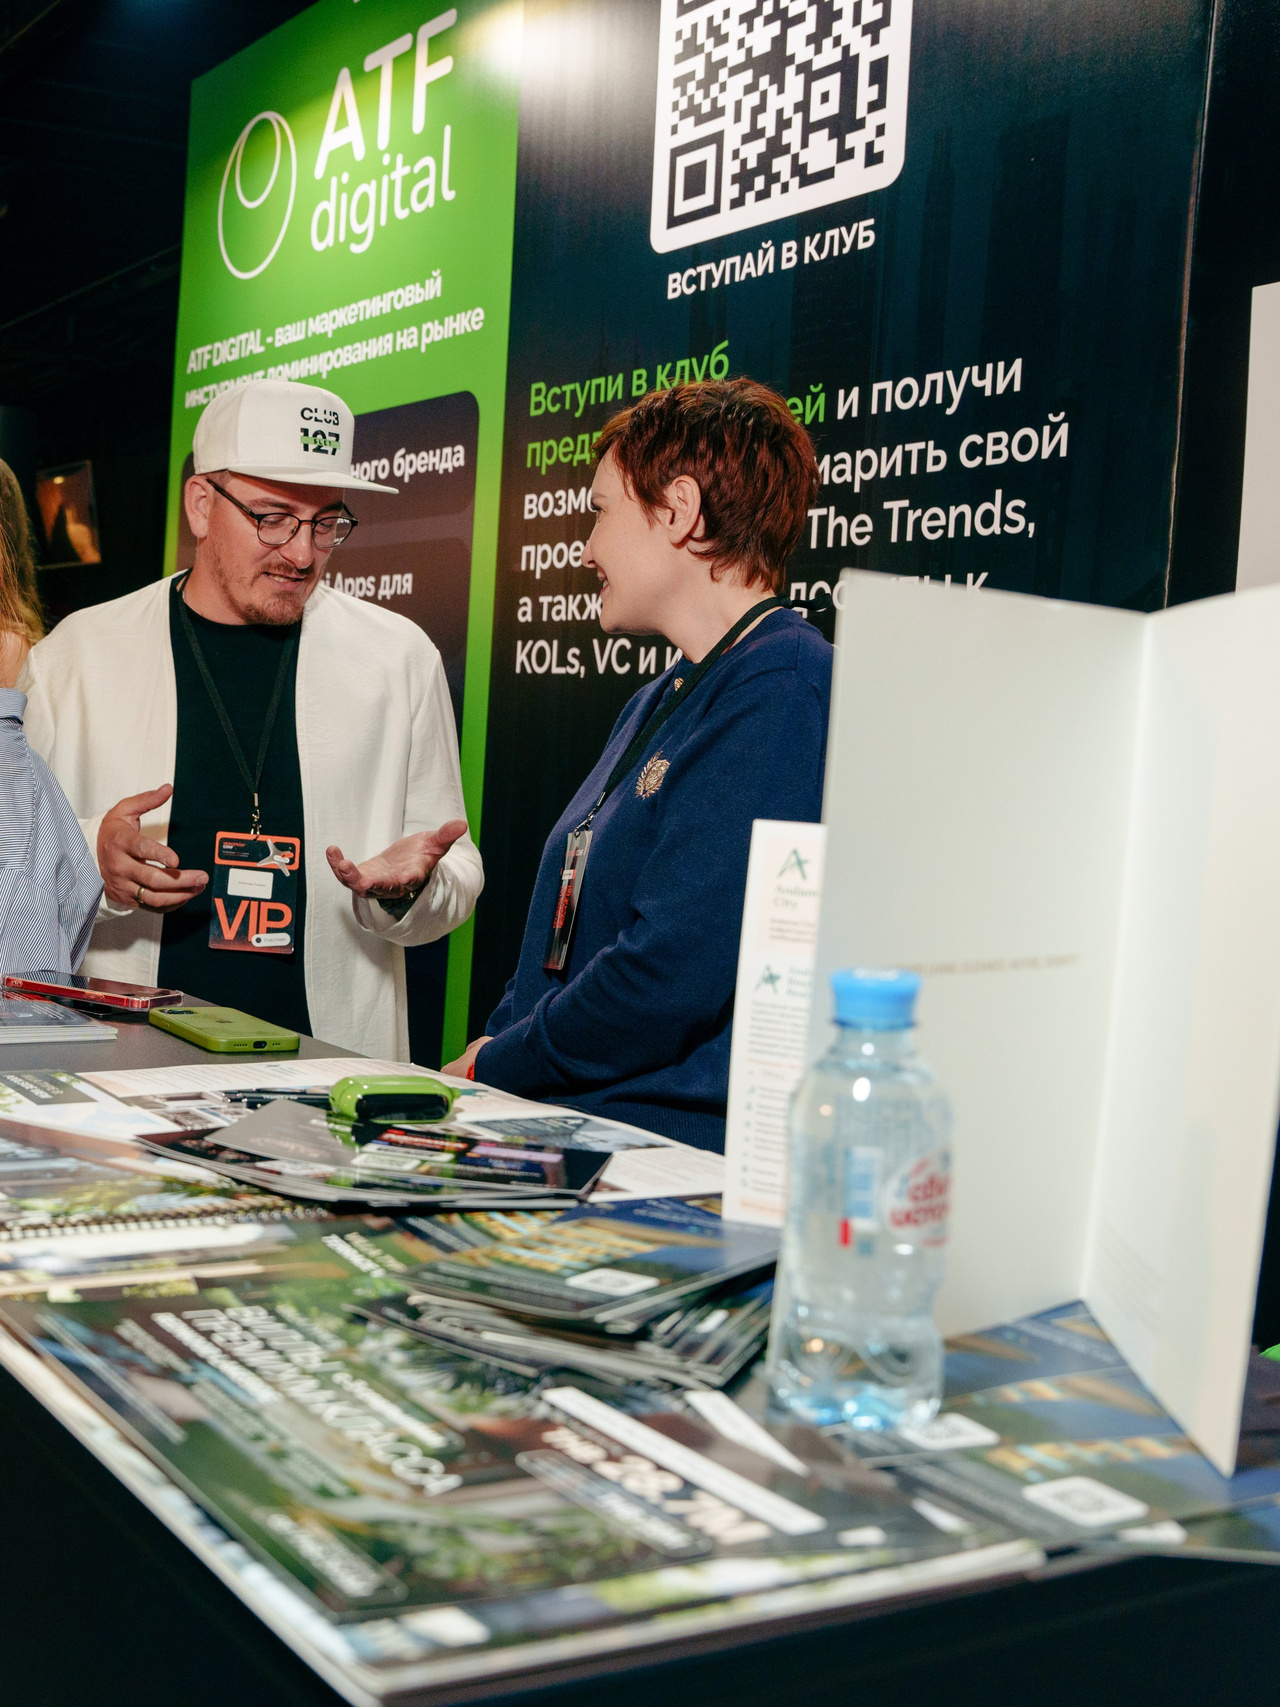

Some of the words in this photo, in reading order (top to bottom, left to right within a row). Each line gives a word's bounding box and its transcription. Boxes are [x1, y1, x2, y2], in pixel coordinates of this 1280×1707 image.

[314, 8, 457, 180] ATF
[311, 124, 456, 253] digital
[667, 242, 774, 300] ВСТУПАЙ
[781, 241, 798, 268] В
[804, 218, 876, 265] КЛУБ
[186, 344, 213, 374] ATF
[212, 328, 265, 367] DIGITAL
[274, 319, 306, 348] ваш
[307, 268, 442, 338] маркетинговый
[396, 326, 418, 353] на
[420, 307, 485, 353] рынке
[529, 372, 623, 418] Вступи
[631, 368, 648, 398] в
[655, 340, 730, 391] клуб
[837, 386, 860, 420] и
[871, 358, 1023, 416] получи
[300, 407, 340, 426] CLUB
[300, 428, 340, 456] 127
[959, 412, 1070, 468] свой
[393, 444, 465, 483] бренда
[807, 506, 873, 549] The
[883, 489, 1036, 543] Trends,
[333, 571, 376, 598] Apps
[377, 573, 414, 601] для
[517, 595, 532, 623] а
[515, 639, 586, 679] KOLs,
[592, 638, 632, 675] VC
[638, 646, 657, 675] и
[213, 897, 293, 942] VIP
